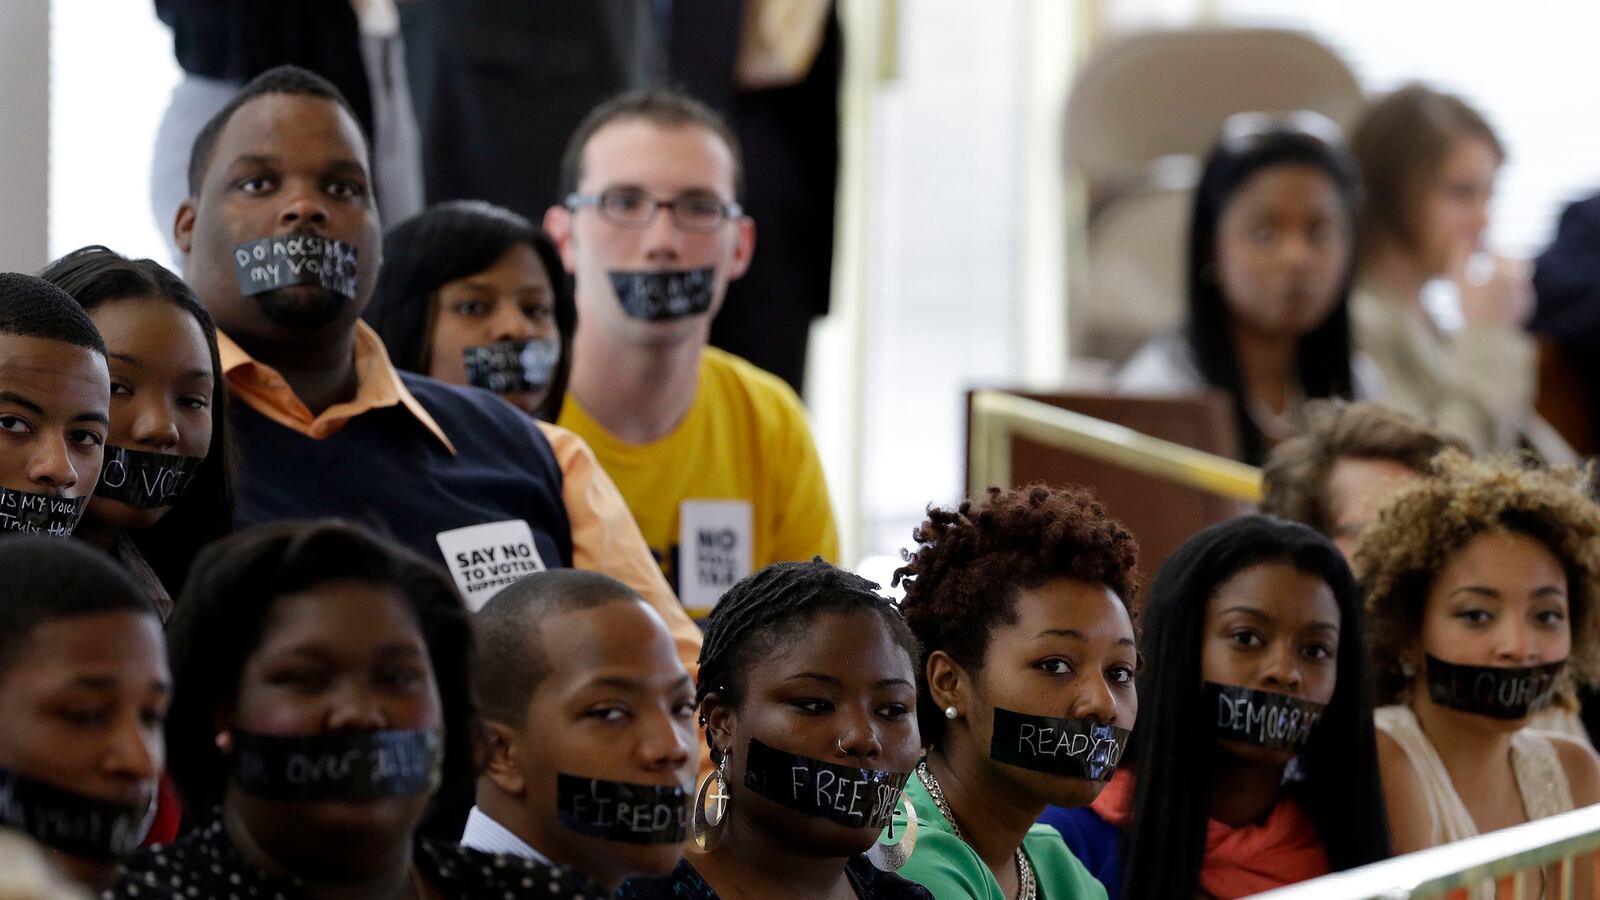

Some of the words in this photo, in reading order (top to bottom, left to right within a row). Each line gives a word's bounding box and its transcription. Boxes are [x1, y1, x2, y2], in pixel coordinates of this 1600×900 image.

[250, 263, 280, 288] my
[698, 528, 737, 552] NO
[456, 546, 496, 568] SAY
[502, 543, 531, 560] NO
[462, 567, 485, 582] TO
[1019, 723, 1101, 762] READY
[1104, 738, 1120, 767] TO
[791, 766, 869, 816] FREE
[573, 793, 673, 833] FIRED
